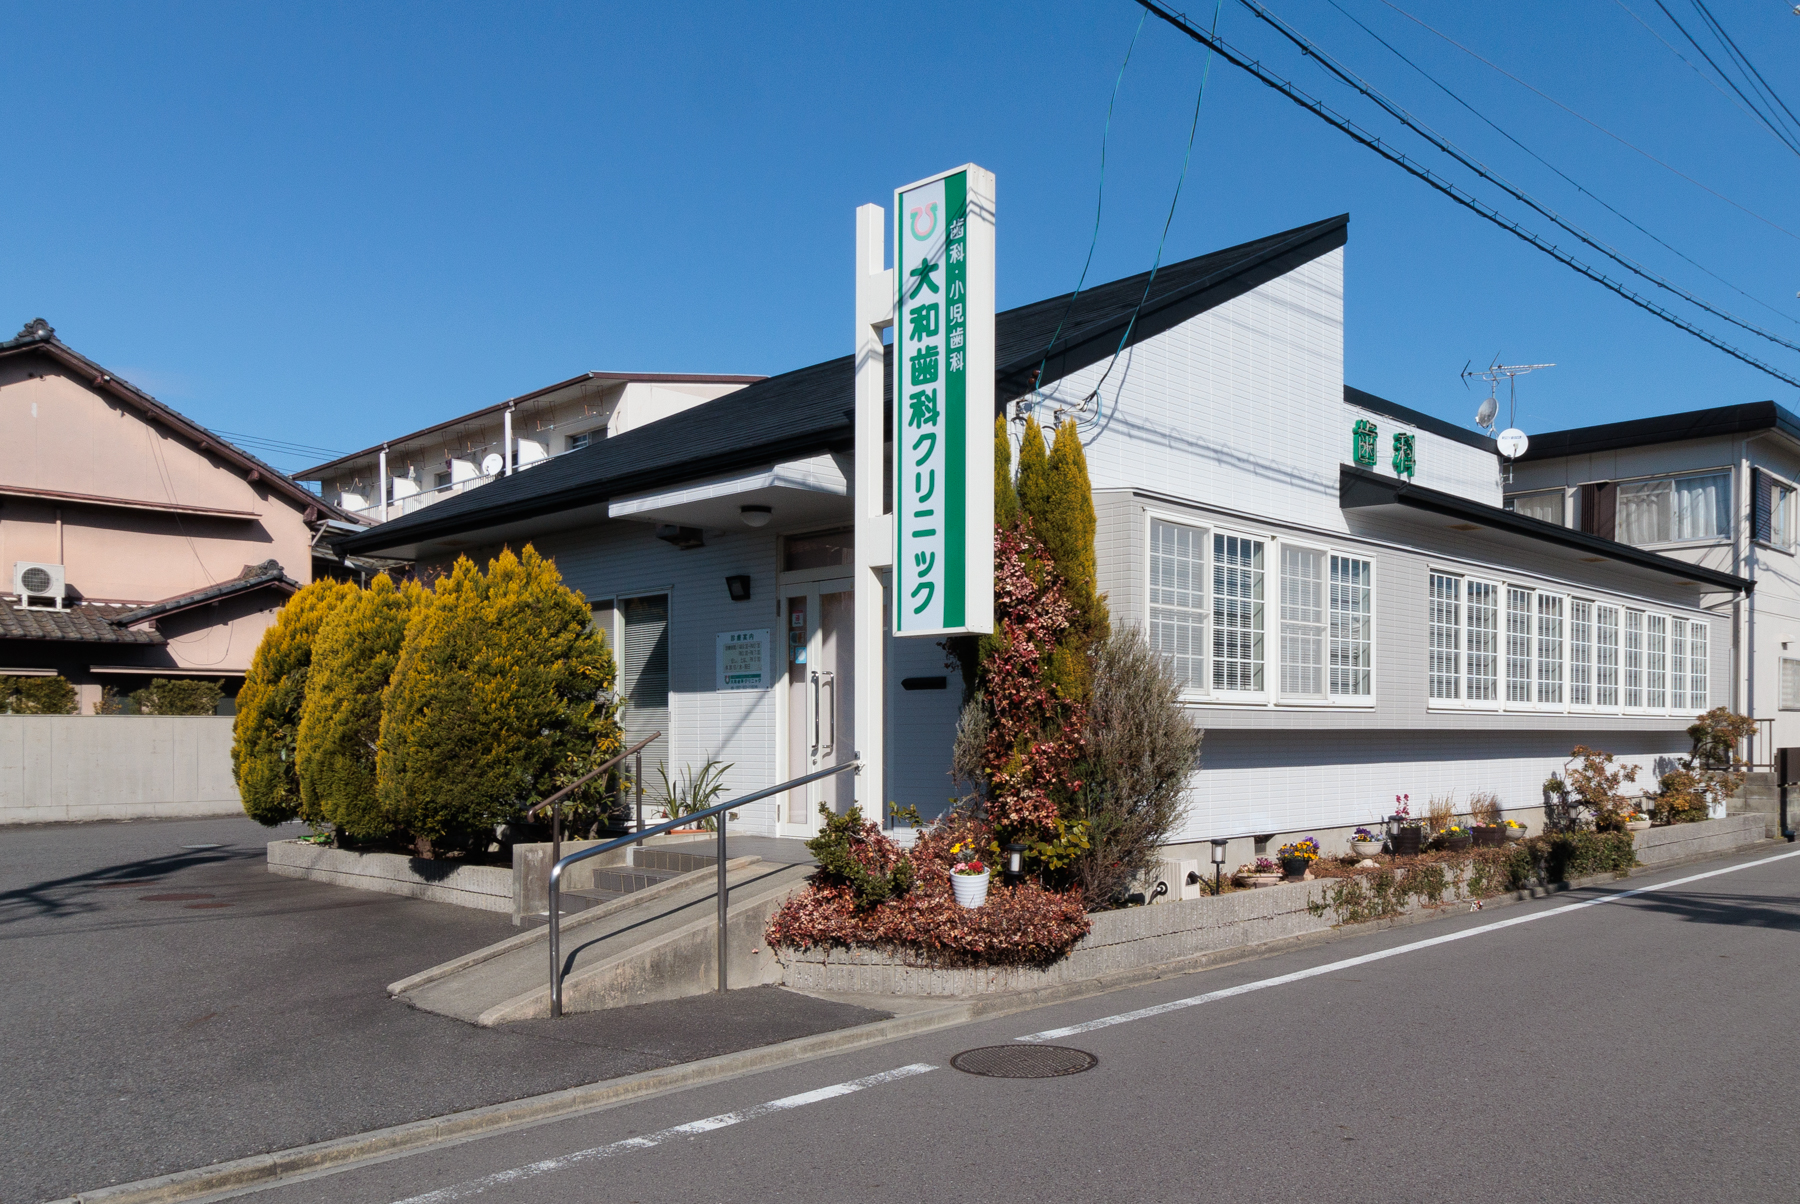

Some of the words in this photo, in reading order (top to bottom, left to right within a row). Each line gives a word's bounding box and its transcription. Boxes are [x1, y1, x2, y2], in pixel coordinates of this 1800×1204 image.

[949, 217, 965, 373] 歯科・小児歯科
[908, 257, 940, 615] 大和歯科クリニック
[1352, 419, 1416, 477] 歯科
